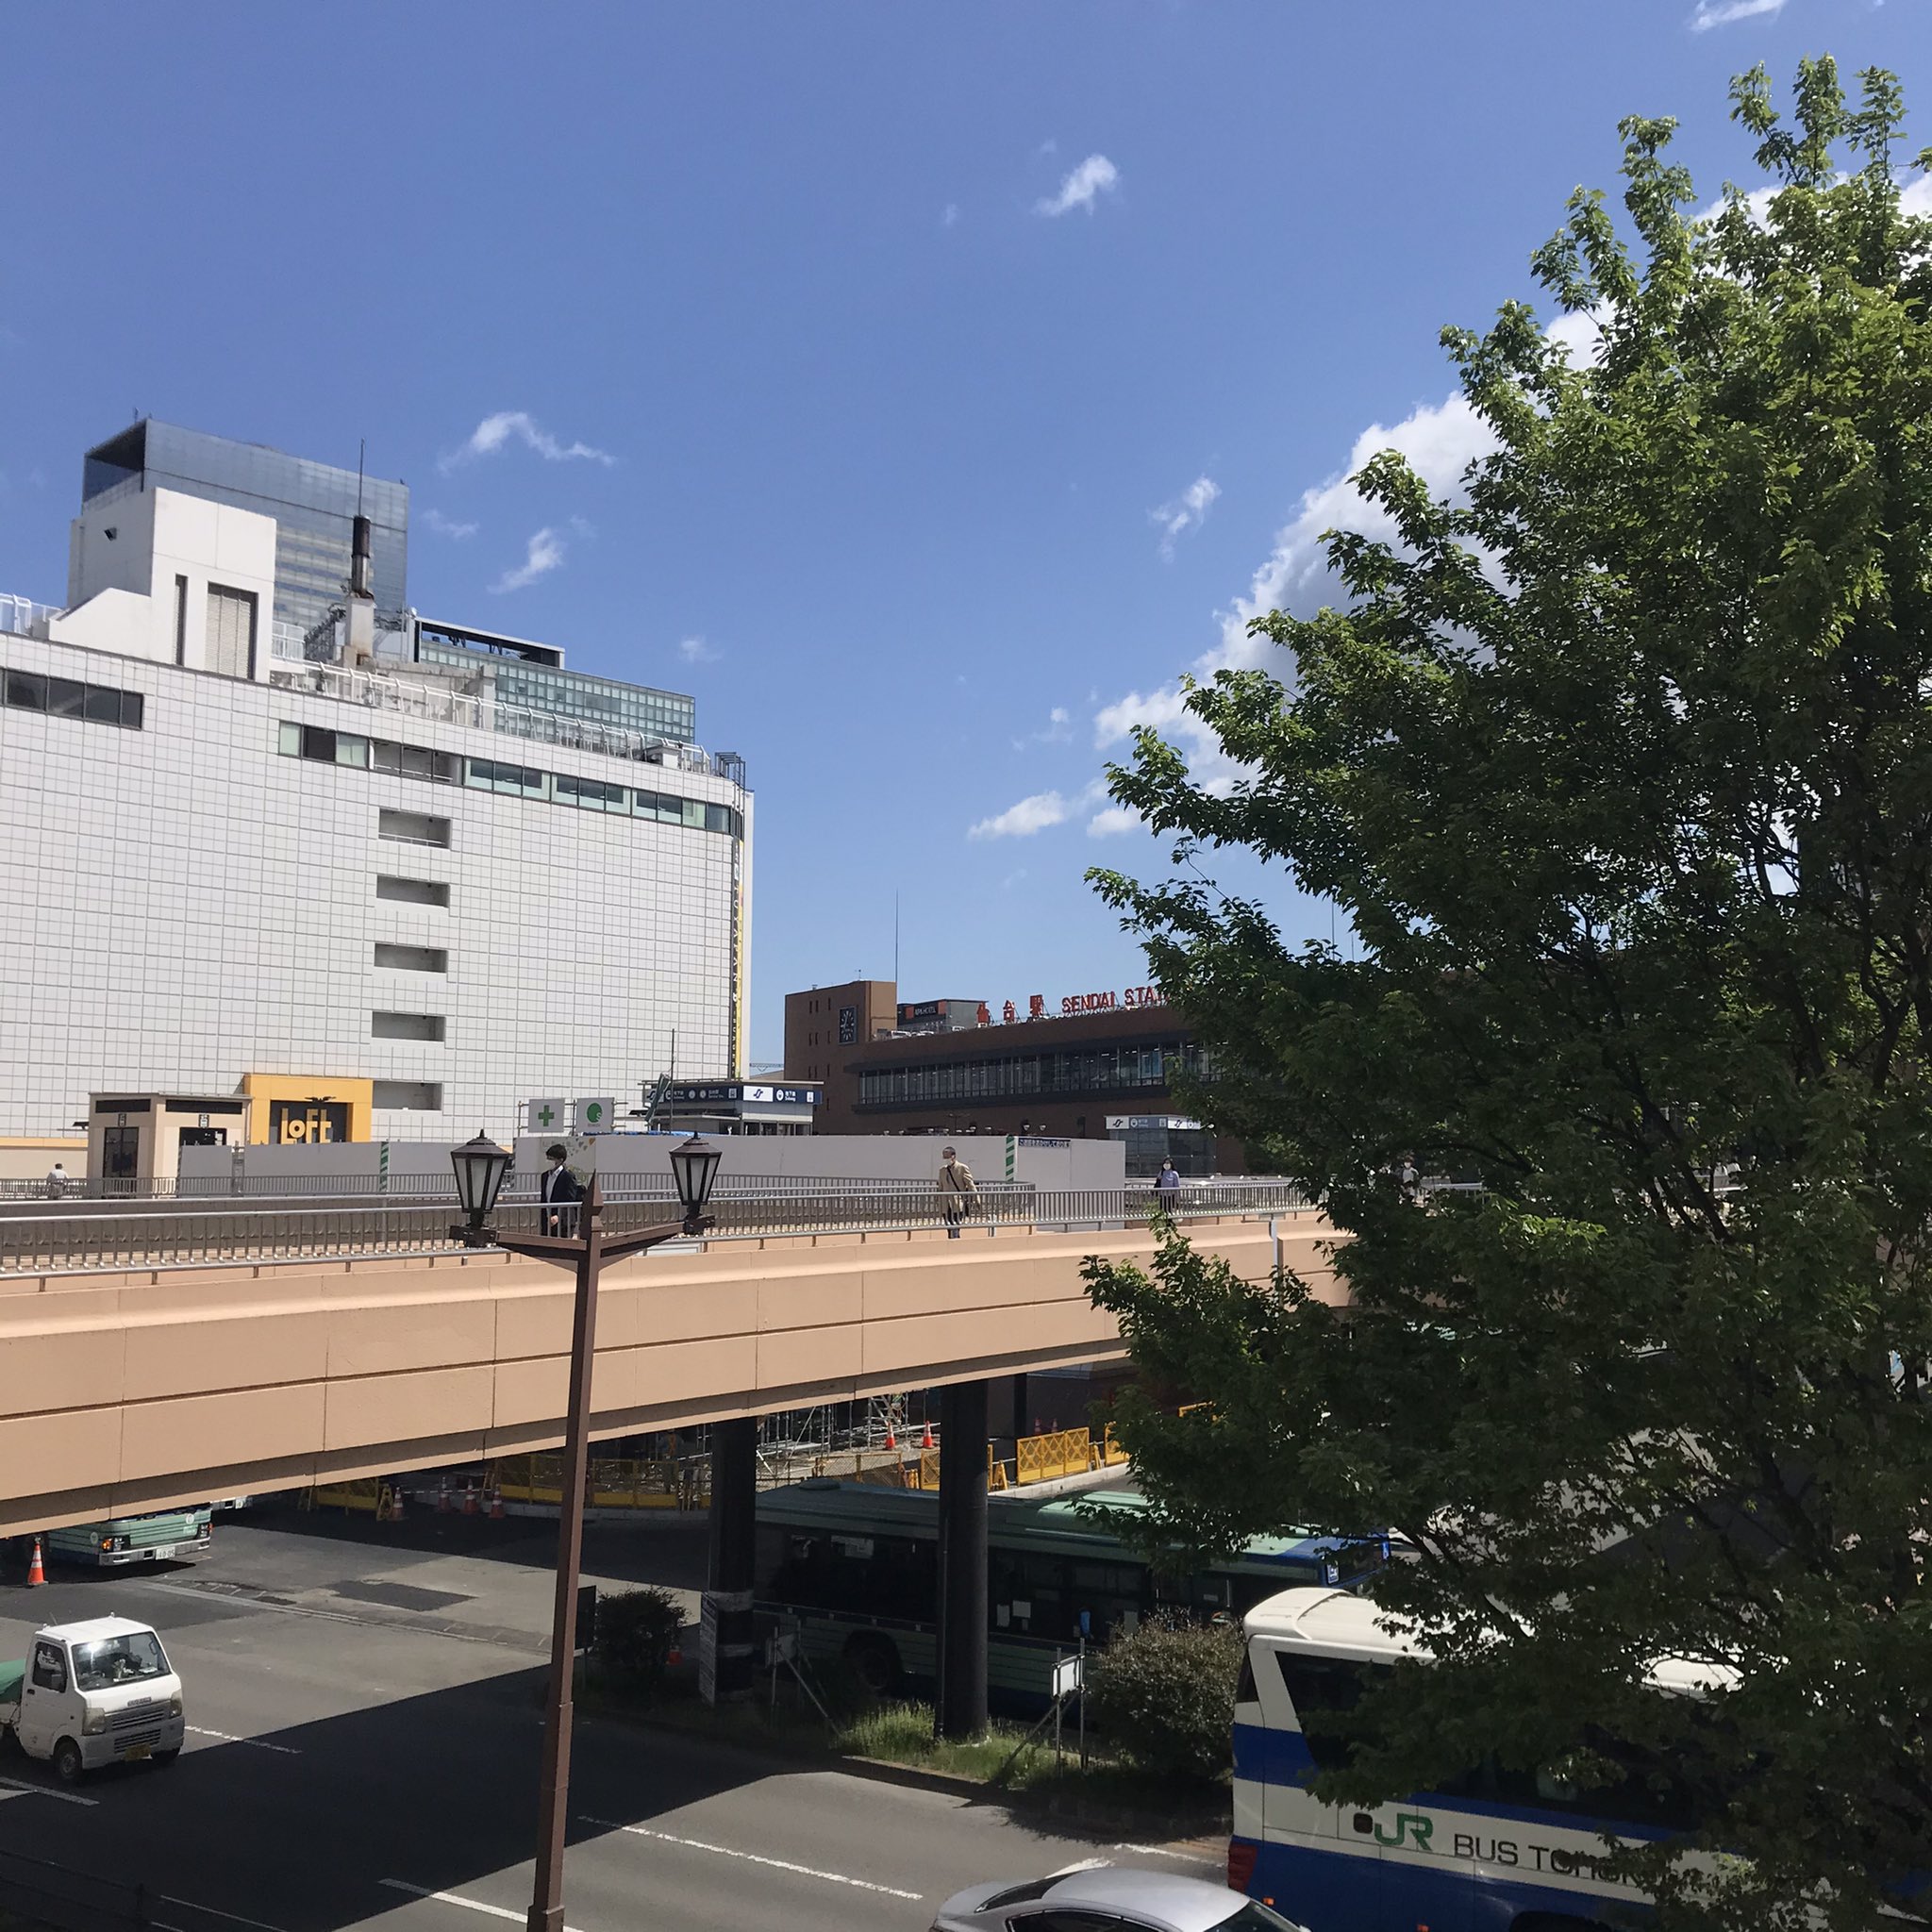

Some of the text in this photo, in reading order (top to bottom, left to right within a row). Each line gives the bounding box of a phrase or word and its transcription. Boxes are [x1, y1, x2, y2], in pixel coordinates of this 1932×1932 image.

[1061, 991, 1116, 1013] SENDAI
[1374, 1813, 1433, 1851] JR
[1454, 1833, 1519, 1865] BUS
